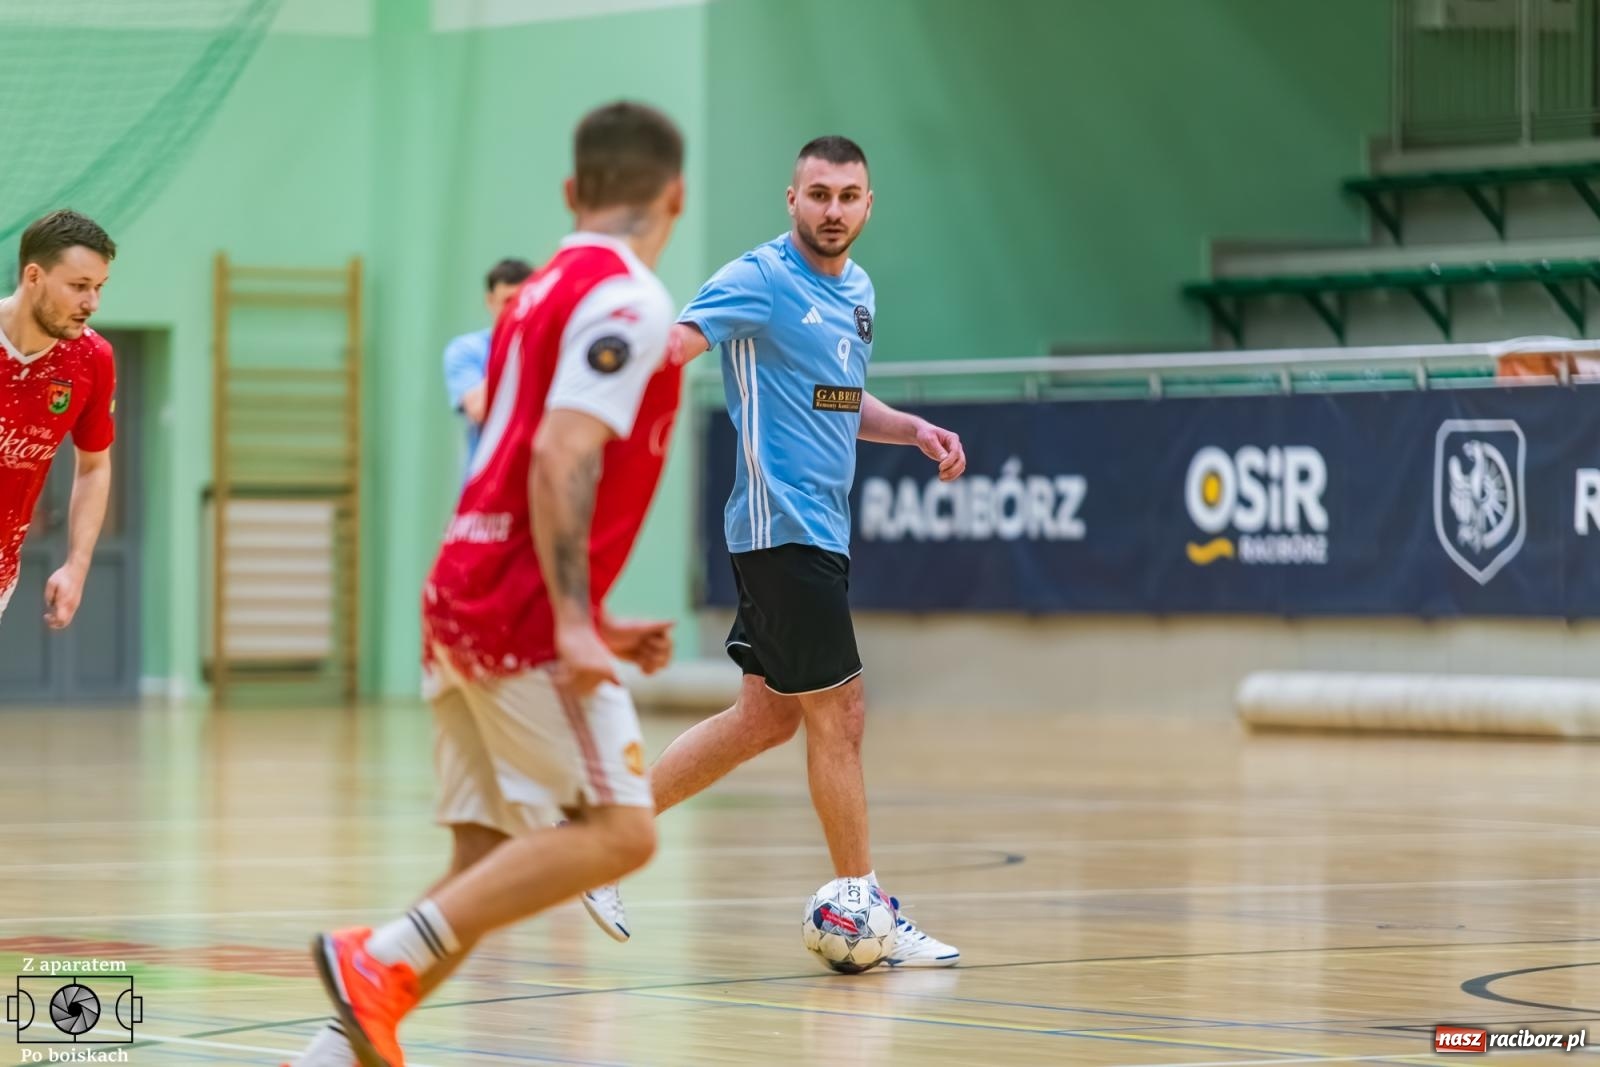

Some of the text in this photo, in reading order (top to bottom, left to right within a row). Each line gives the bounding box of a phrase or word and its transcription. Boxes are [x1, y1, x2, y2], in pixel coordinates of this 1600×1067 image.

[838, 337, 851, 372] 9
[816, 388, 860, 402] GABRIEL
[0, 425, 58, 460] iktori
[860, 456, 1087, 541] RACIBÓRZ
[1185, 445, 1328, 534] OSiR
[848, 878, 861, 904] ECT
